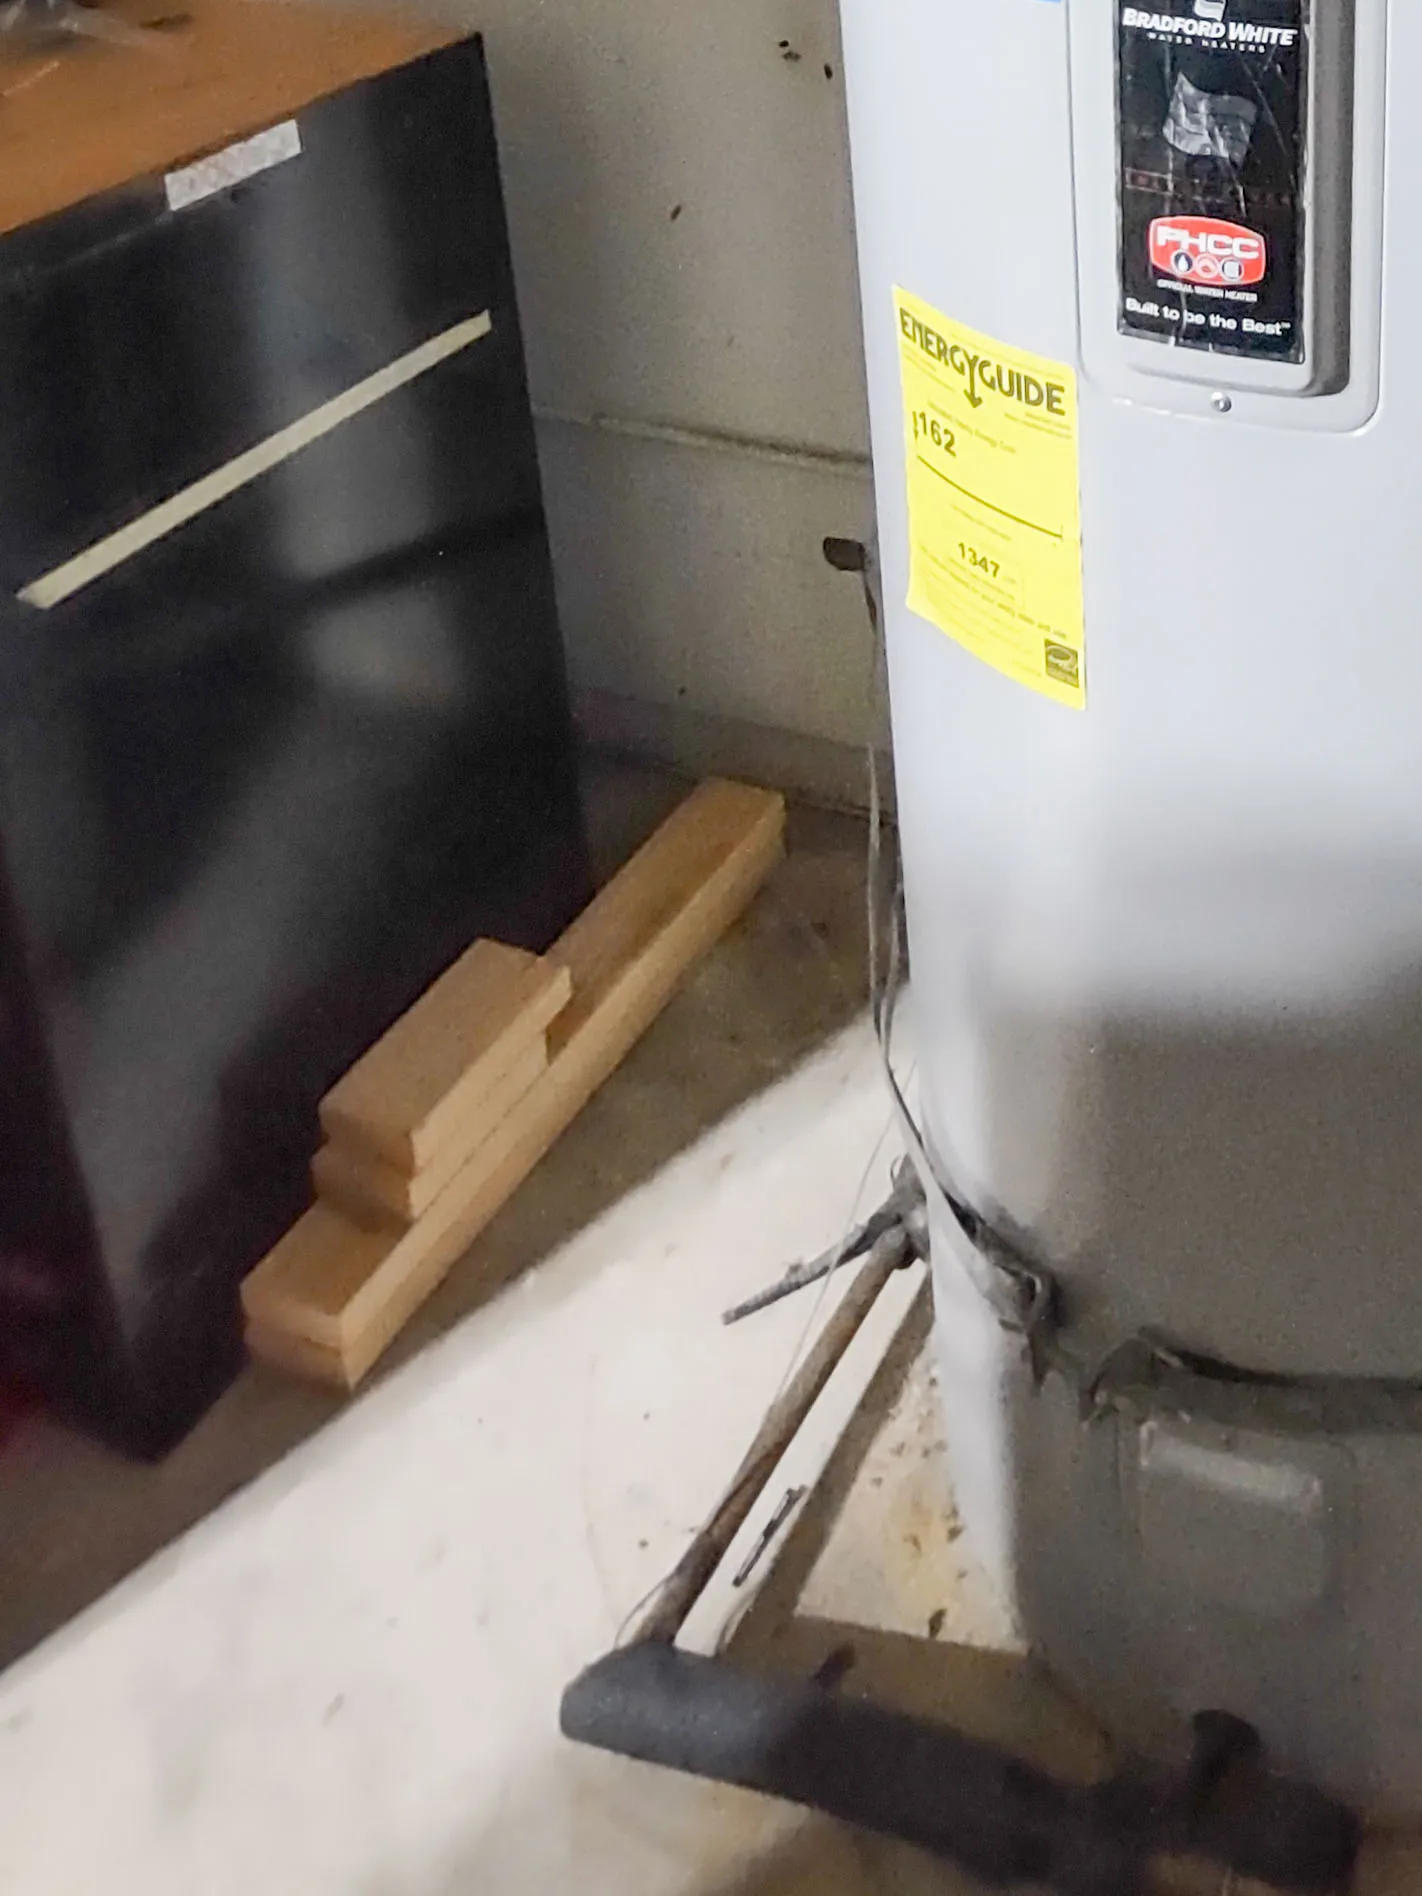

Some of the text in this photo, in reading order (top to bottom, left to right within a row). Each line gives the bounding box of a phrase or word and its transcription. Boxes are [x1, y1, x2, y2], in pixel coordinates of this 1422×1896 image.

[1122, 7, 1298, 46] BRADFORD WHITE
[1156, 225, 1260, 260] PHCC
[1126, 296, 1160, 317] Built
[1162, 304, 1181, 321] to
[1183, 308, 1206, 325] be
[1209, 312, 1238, 331] the
[920, 410, 957, 459] 162
[958, 541, 1001, 579] 1347
